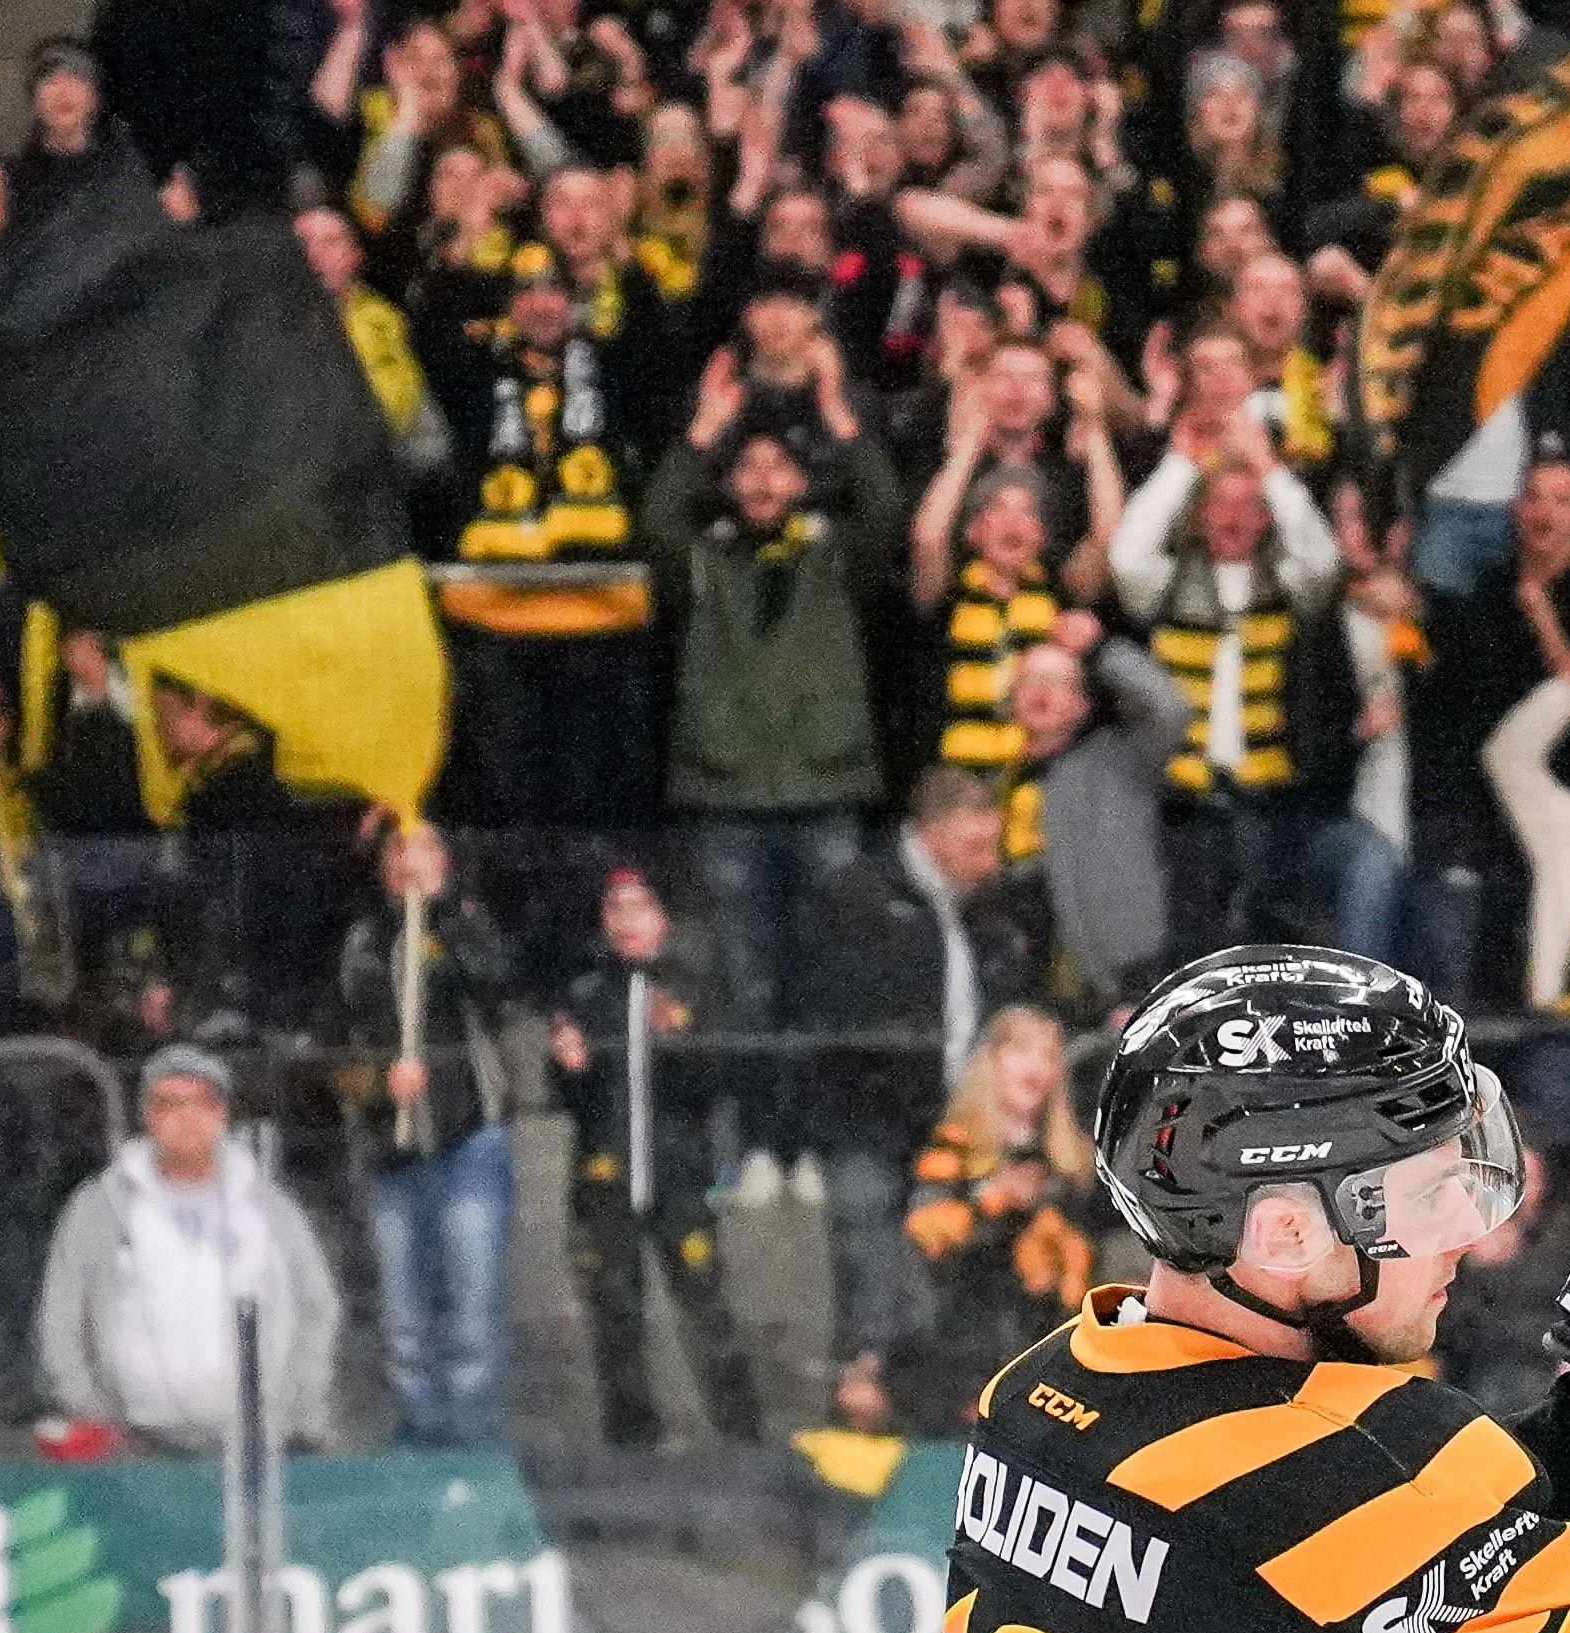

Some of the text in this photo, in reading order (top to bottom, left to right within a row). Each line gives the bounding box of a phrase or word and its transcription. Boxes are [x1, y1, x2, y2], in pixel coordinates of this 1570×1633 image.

[1294, 1037, 1336, 1051] Kraft
[1240, 1141, 1333, 1165] CCM
[1028, 1382, 1100, 1431] CCM
[1459, 1510, 1540, 1580] Skelleft
[1470, 1548, 1517, 1601] Kraft
